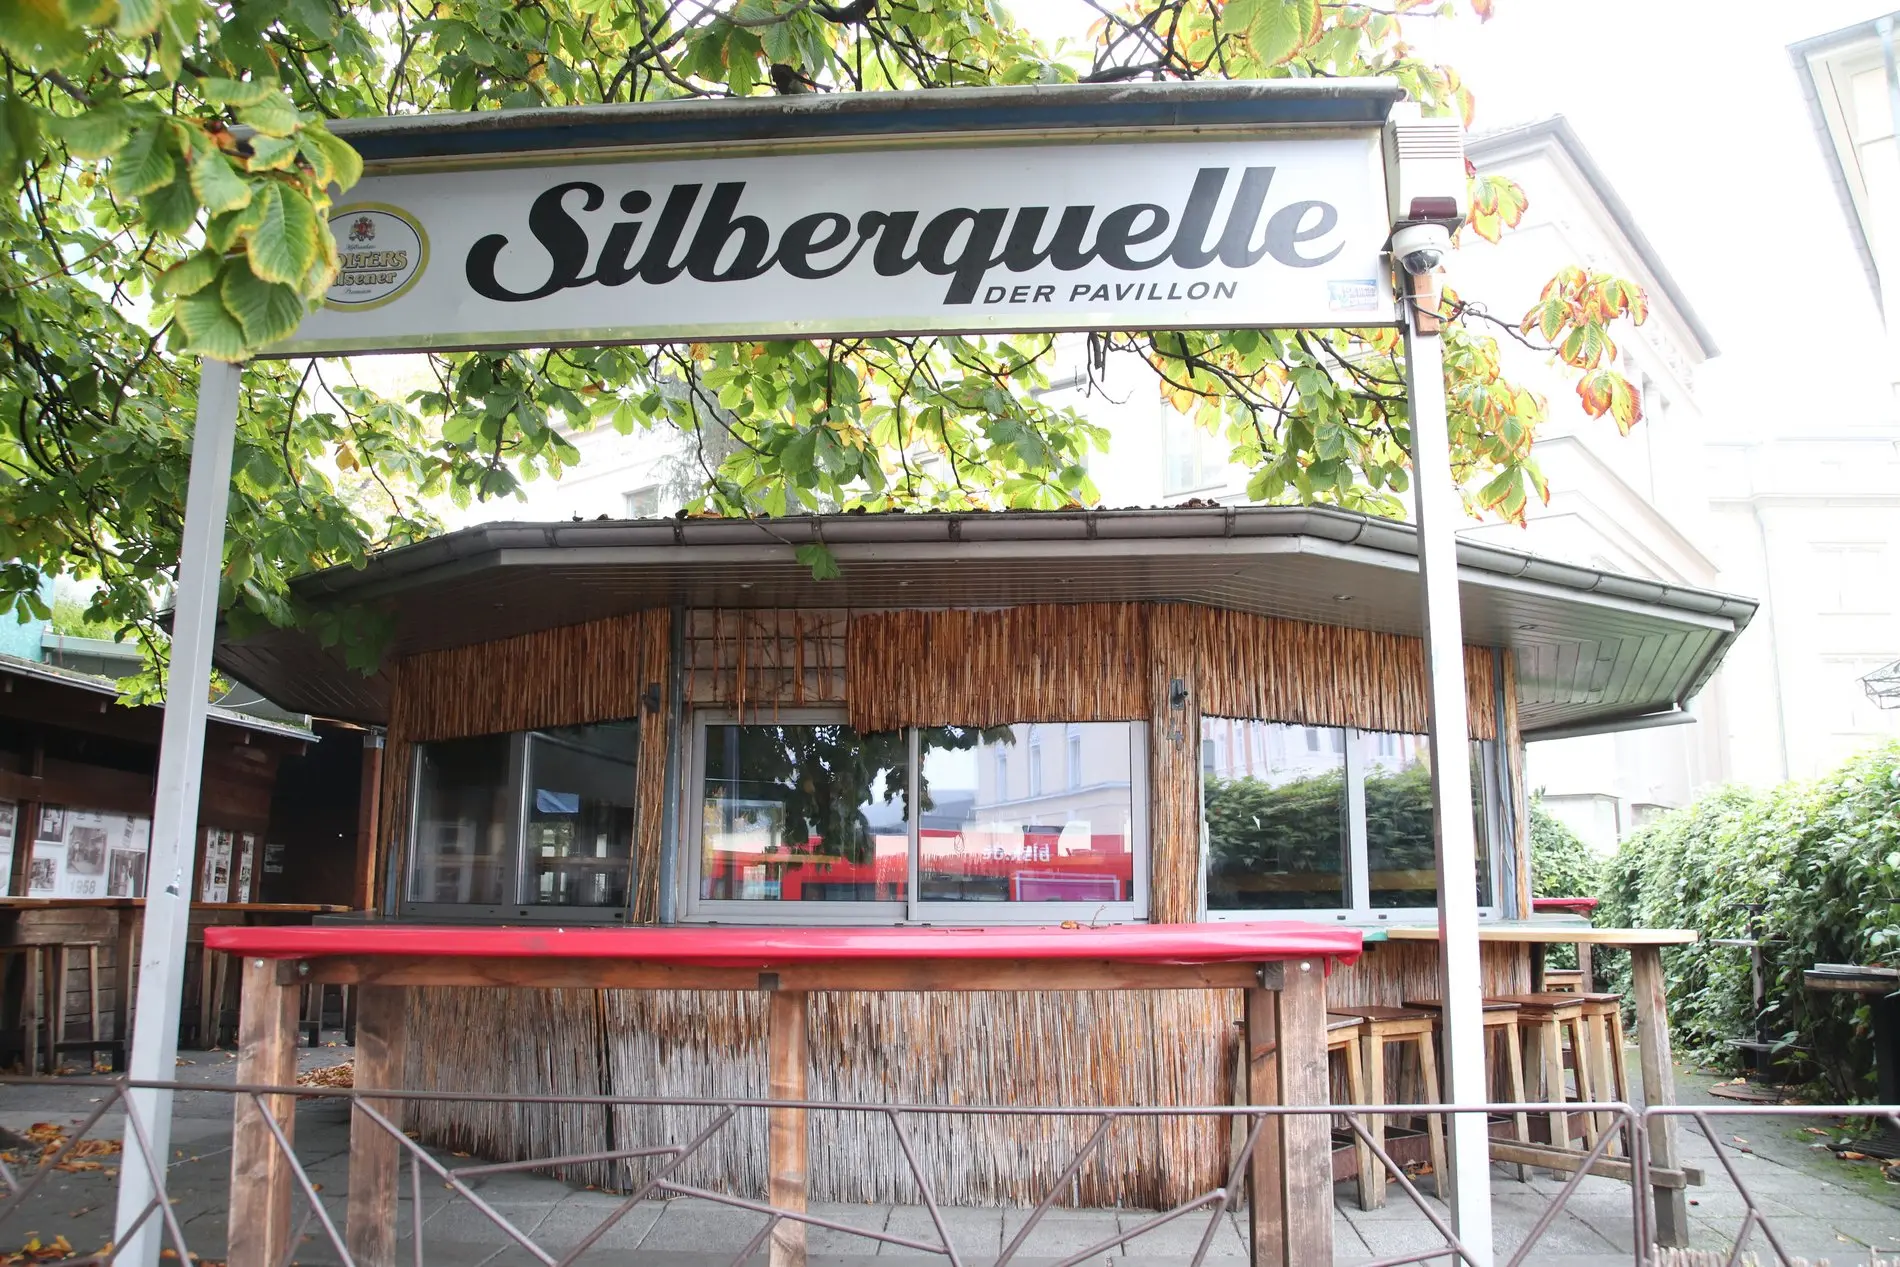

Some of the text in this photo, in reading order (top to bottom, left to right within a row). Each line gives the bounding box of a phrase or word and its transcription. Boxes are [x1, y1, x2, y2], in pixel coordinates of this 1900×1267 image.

[466, 166, 1345, 306] Silberquelle
[983, 281, 1239, 304] DER PAVILLON
